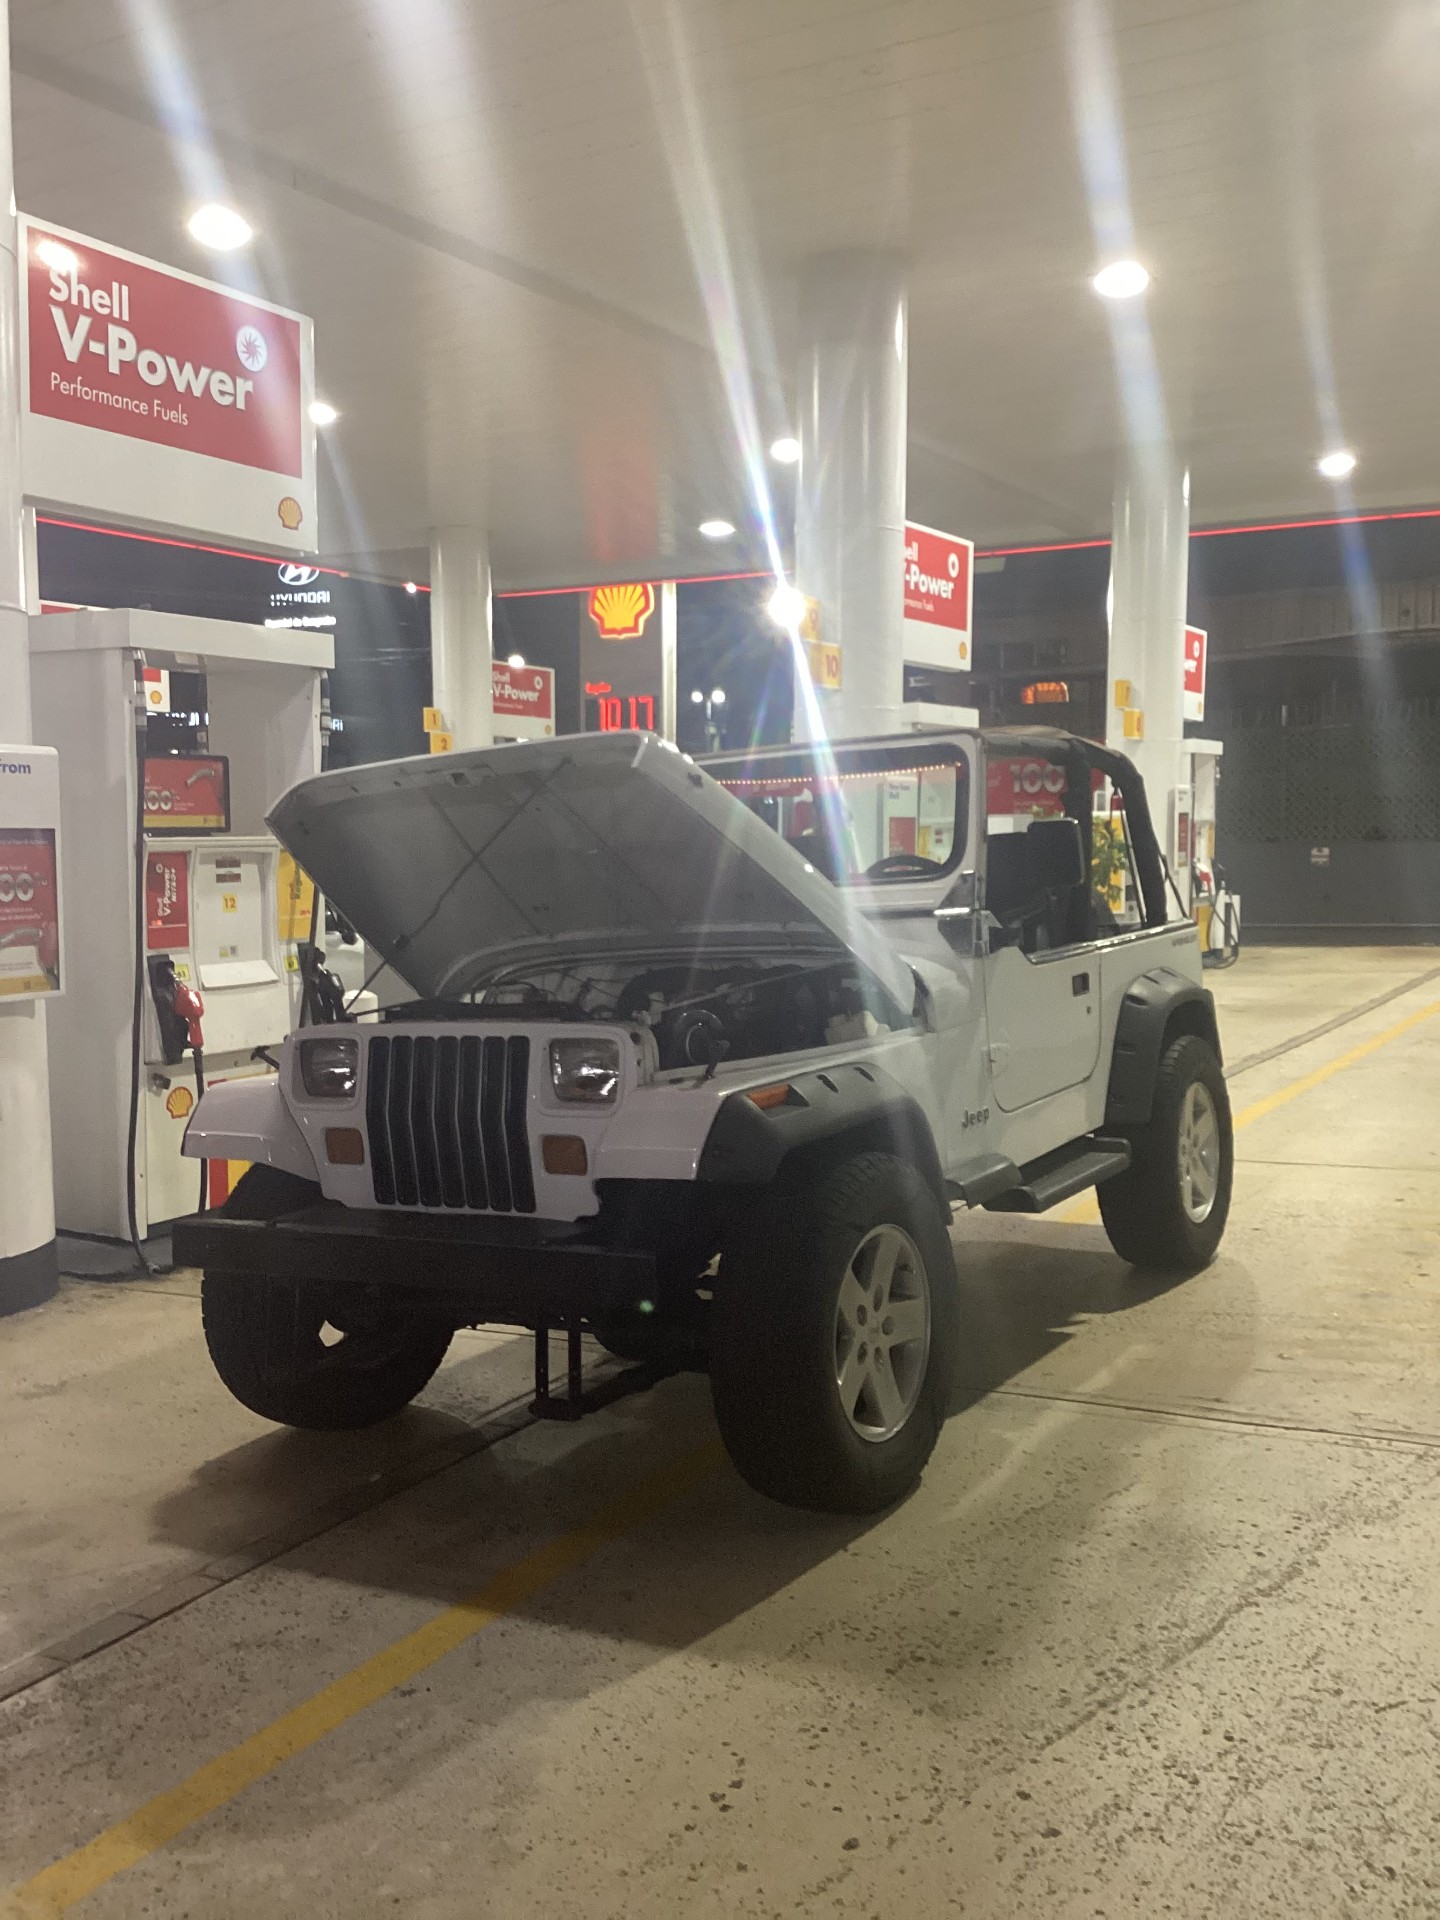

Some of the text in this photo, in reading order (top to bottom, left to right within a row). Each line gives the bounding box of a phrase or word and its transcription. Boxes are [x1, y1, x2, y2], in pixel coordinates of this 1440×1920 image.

[49, 263, 129, 322] Shell
[49, 304, 253, 411] V-Power
[50, 371, 189, 426] Performance Fuels
[825, 654, 838, 678] 10
[493, 683, 540, 702] V-Power
[223, 896, 237, 910] 12
[960, 1107, 989, 1129] Jeep
